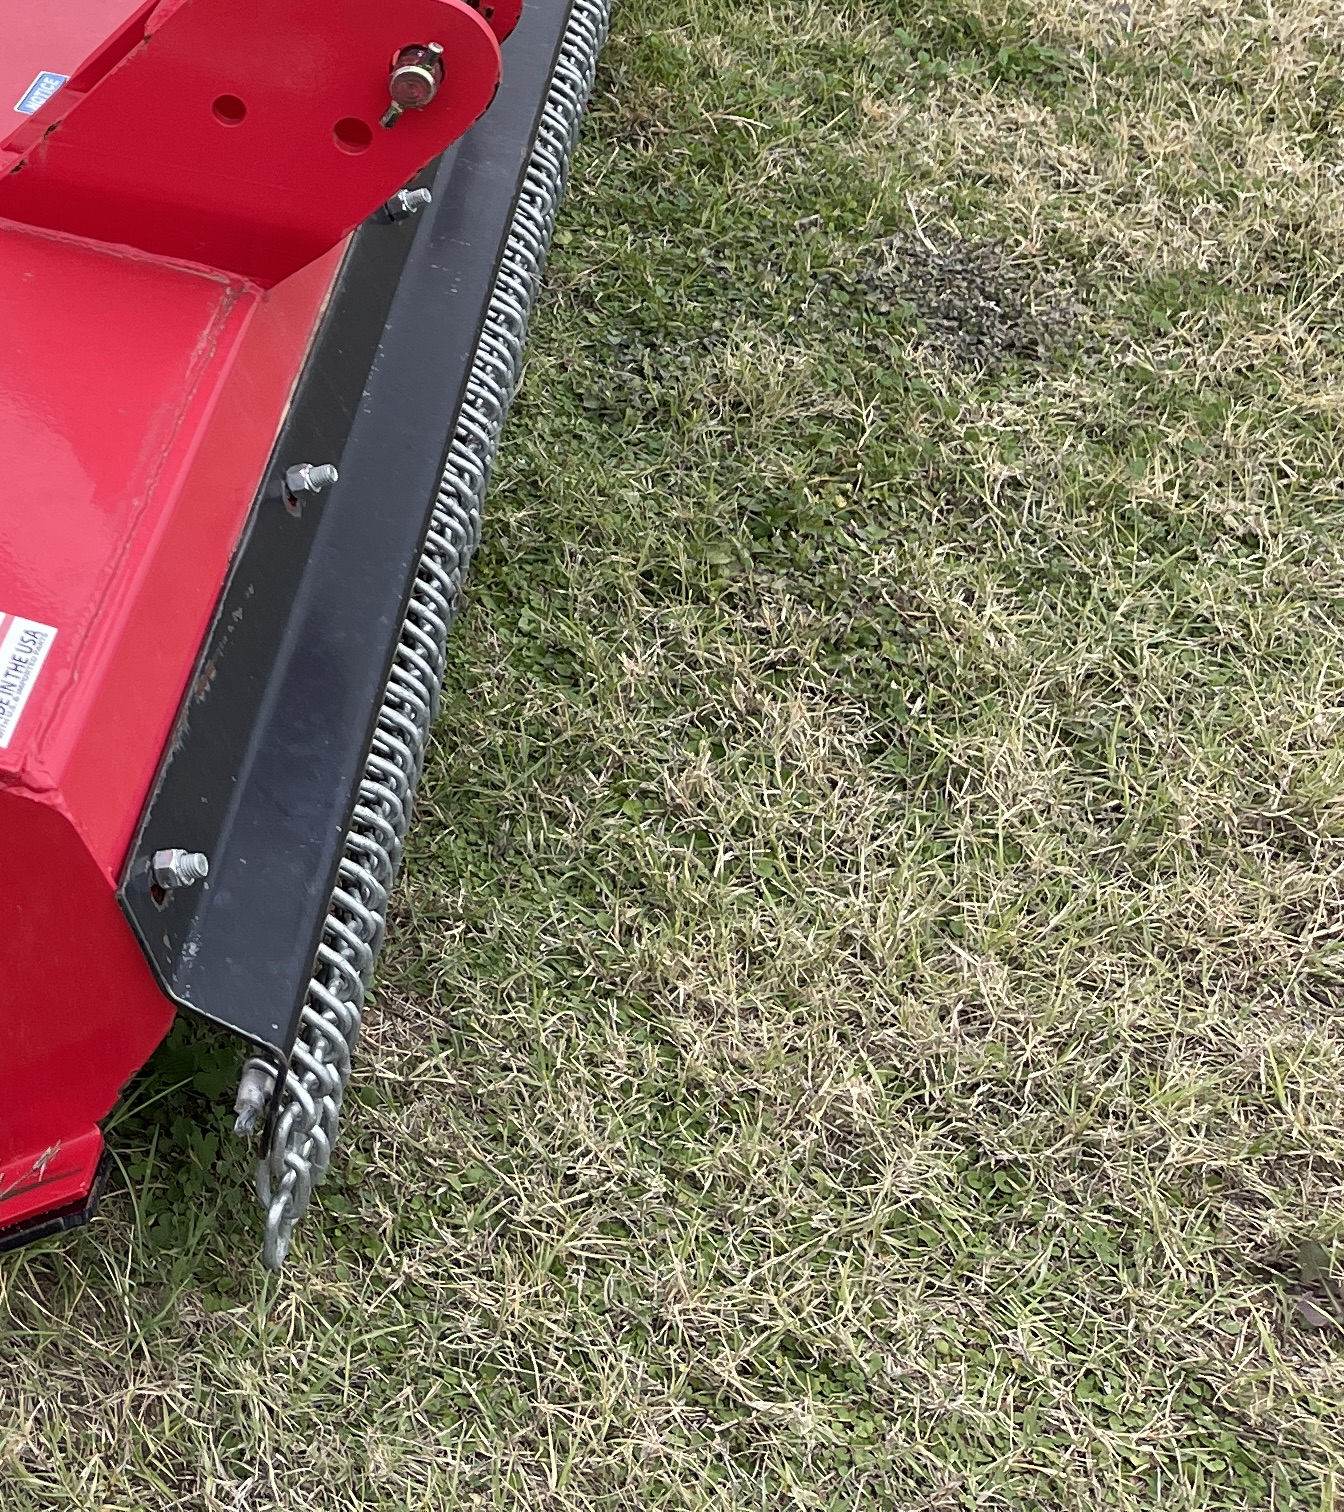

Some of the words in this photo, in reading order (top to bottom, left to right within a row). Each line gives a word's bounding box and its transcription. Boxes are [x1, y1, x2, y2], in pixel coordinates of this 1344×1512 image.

[24, 76, 60, 111] NOTICE
[15, 629, 44, 655] USA
[3, 654, 30, 680] THE
